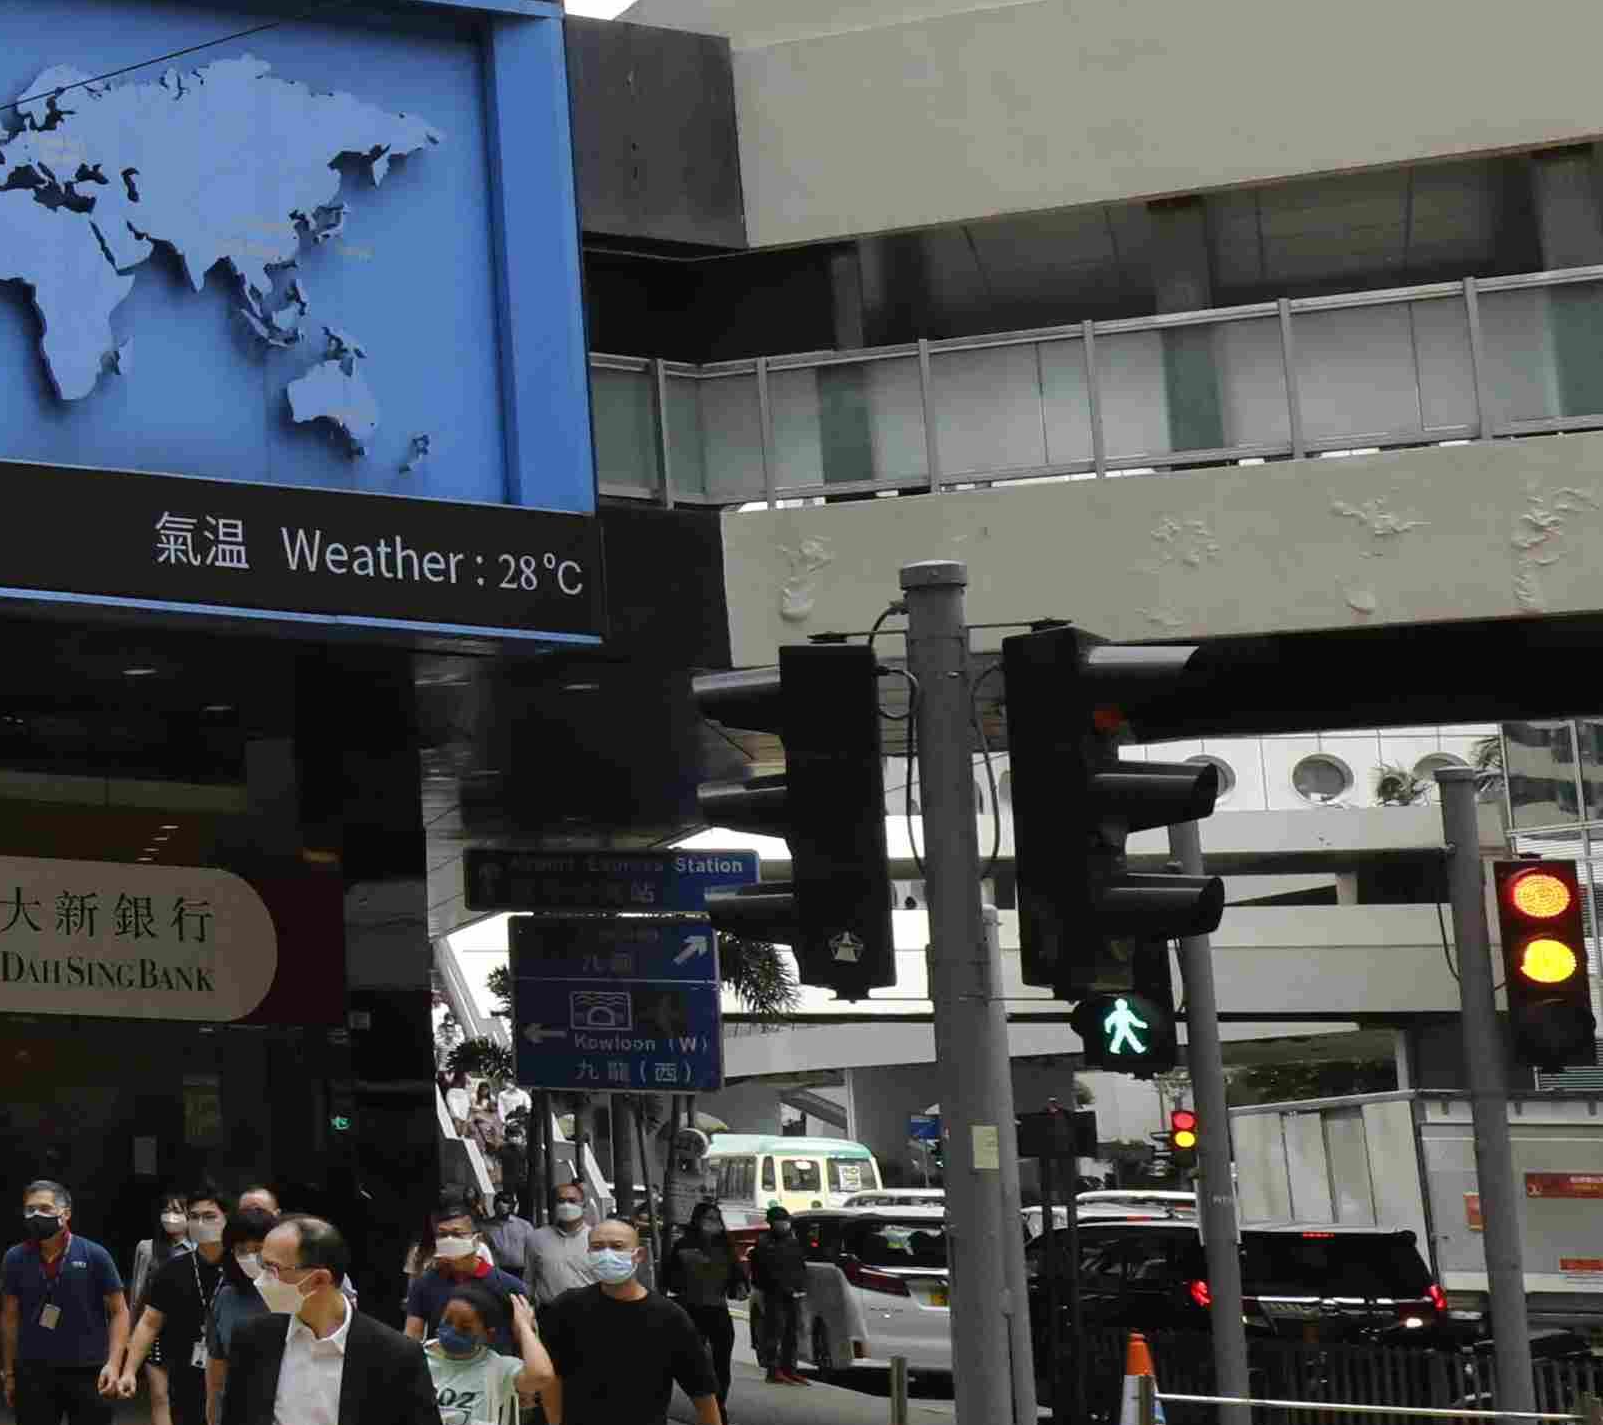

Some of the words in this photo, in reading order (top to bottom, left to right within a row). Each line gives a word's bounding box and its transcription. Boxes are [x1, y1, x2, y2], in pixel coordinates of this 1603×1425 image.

[280, 526, 464, 585] Weather
[673, 856, 744, 874] Station
[574, 1033, 656, 1053] Kowloon
